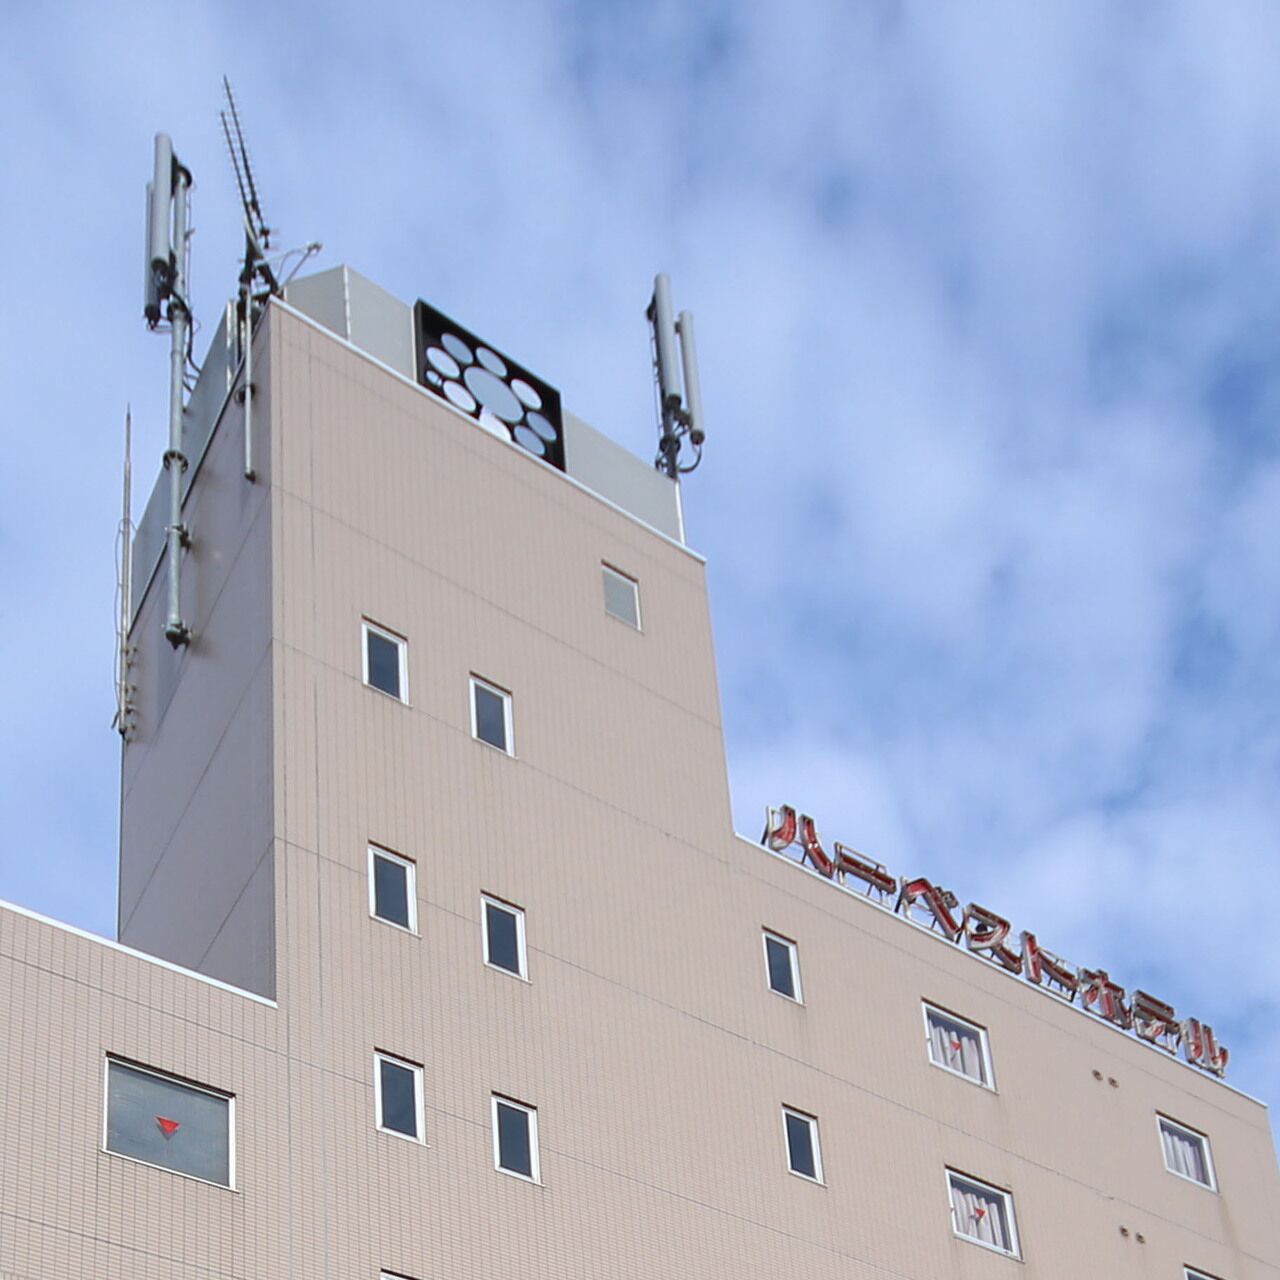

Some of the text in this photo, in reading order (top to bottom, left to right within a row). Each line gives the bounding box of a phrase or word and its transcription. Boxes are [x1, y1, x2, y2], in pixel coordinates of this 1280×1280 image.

[766, 803, 1230, 1077] ハーベストホテル
